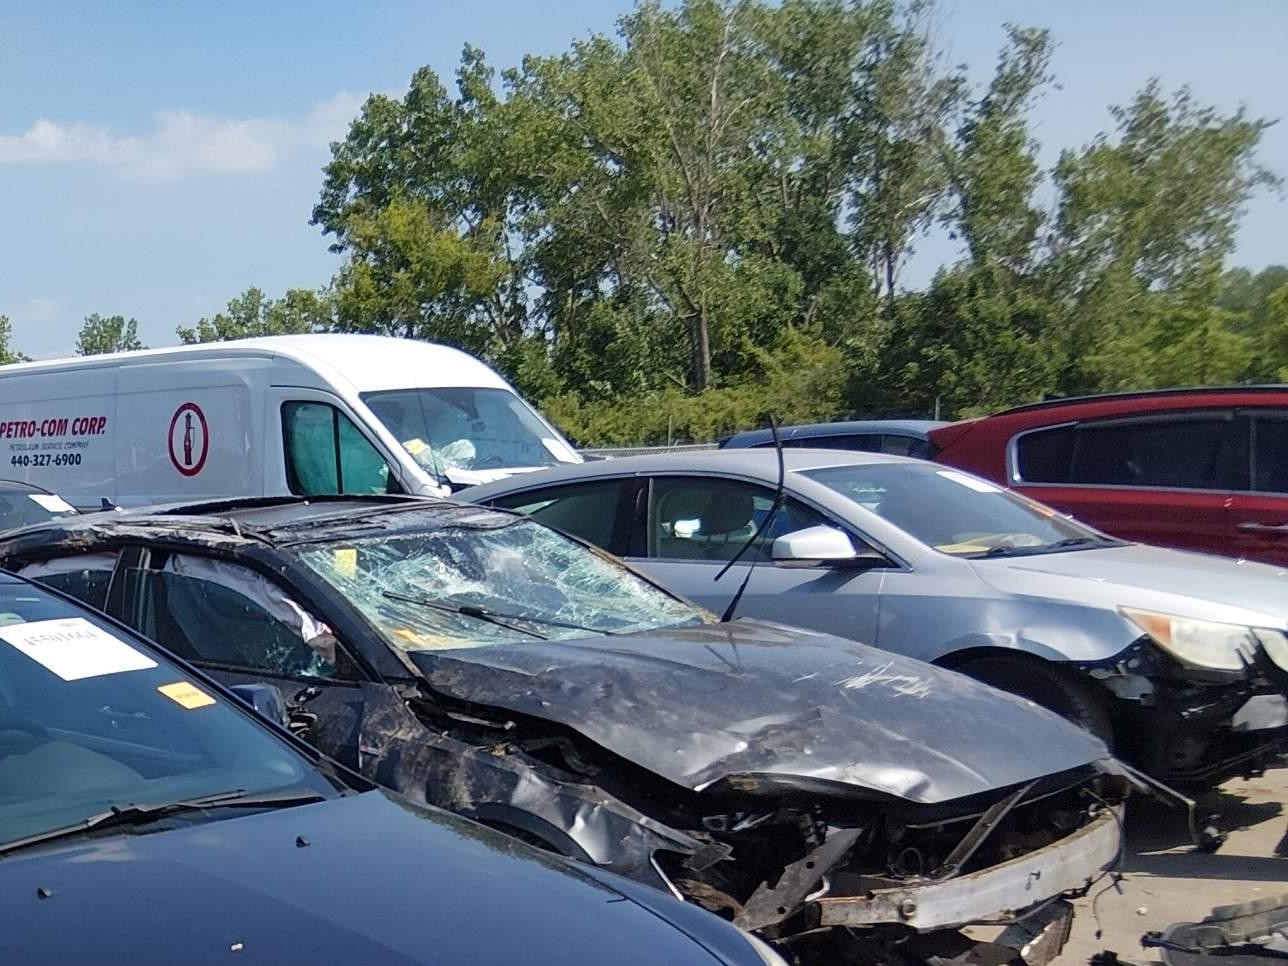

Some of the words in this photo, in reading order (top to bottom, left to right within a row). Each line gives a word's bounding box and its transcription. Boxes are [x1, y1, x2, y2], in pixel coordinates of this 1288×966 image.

[0, 418, 69, 439] PETRO-COM
[72, 416, 107, 436] CORP.
[11, 453, 82, 467] 440-327-6900
